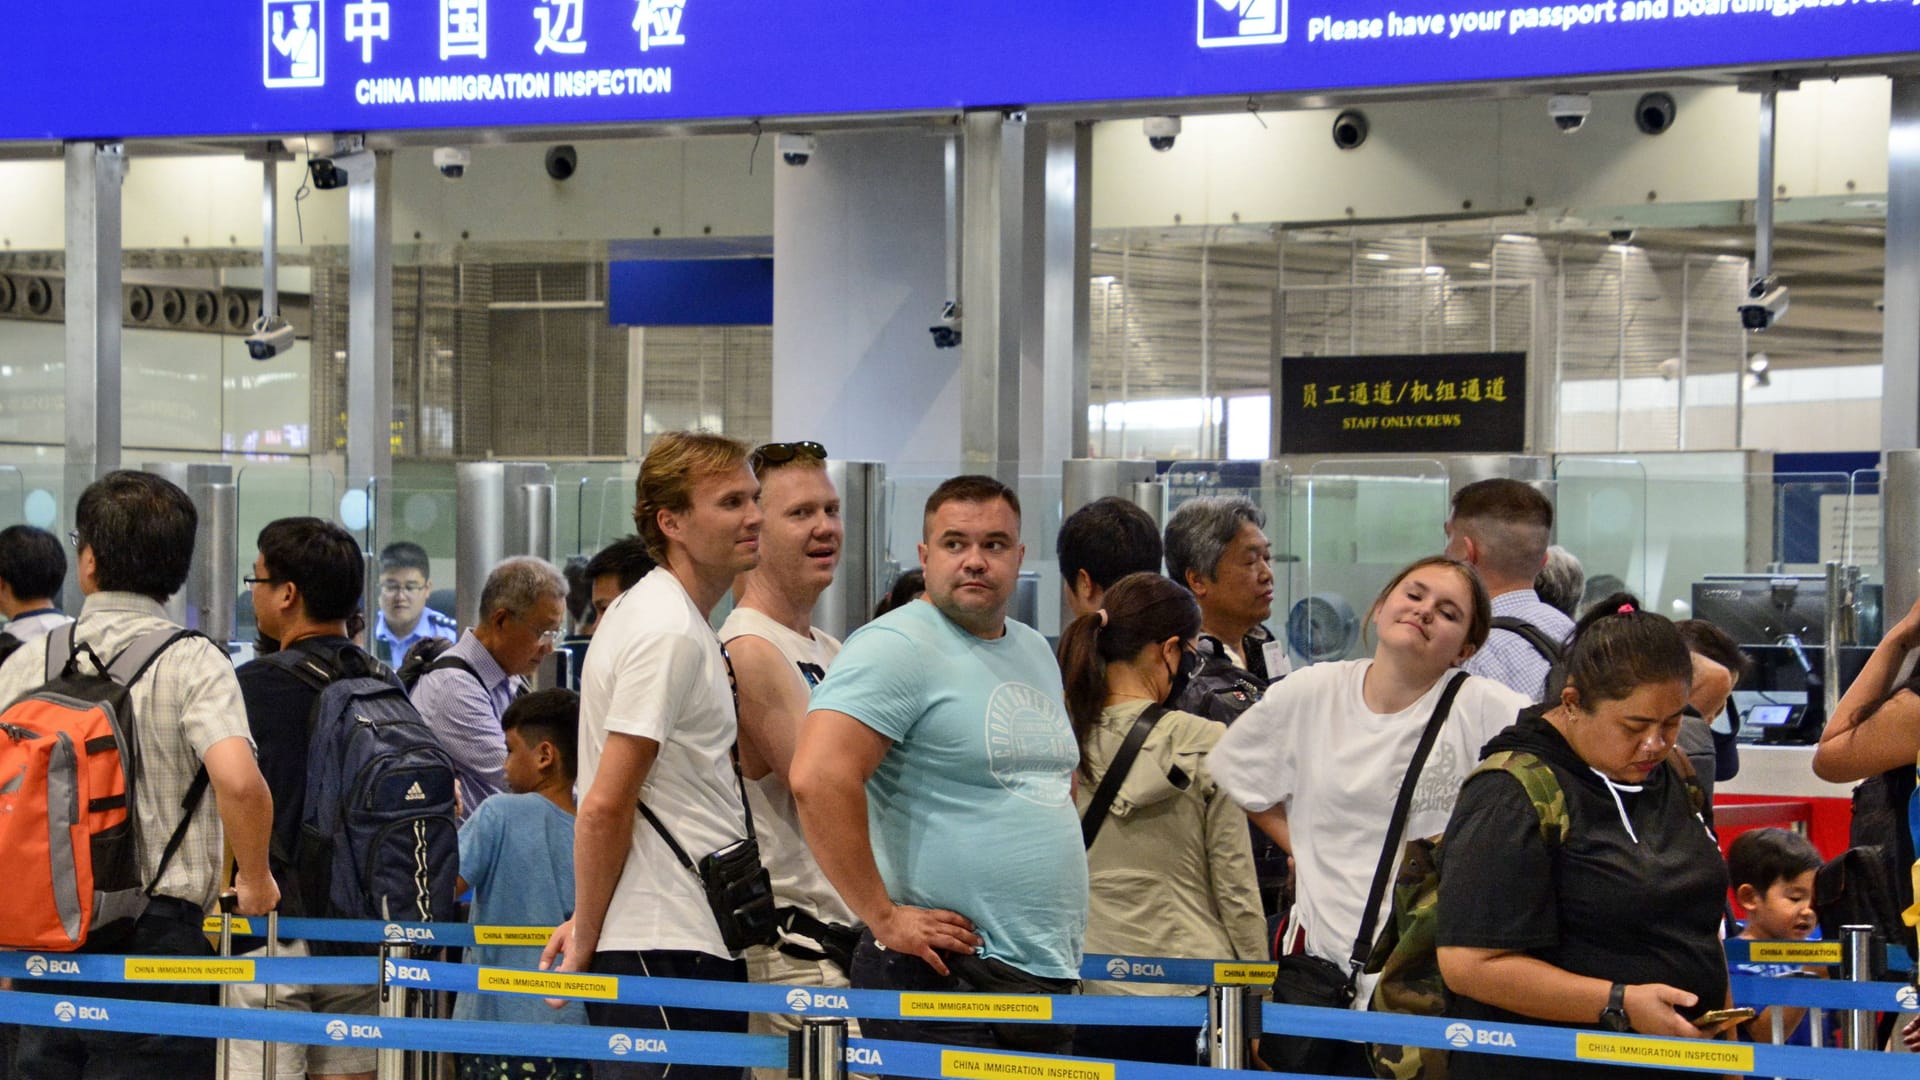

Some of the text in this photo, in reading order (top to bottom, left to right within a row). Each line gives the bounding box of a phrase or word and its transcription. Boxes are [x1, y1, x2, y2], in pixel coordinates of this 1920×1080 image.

[1308, 15, 1384, 42] Please
[1388, 10, 1446, 37] have
[1449, 9, 1506, 39] your
[1509, 0, 1617, 35] passport
[1620, 0, 1668, 21] and
[355, 67, 672, 105] CHINA IMMIGRATION INSPECTION
[1303, 376, 1508, 408] 员工通道/机组通道
[1342, 414, 1462, 430] STAFF ONLY/CREWS
[406, 927, 435, 940] BCIA
[483, 932, 502, 940] CHINA
[504, 932, 546, 940] IMMIGRATION
[1786, 949, 1837, 957] IMMIGRATION
[50, 960, 80, 974] BCIA
[134, 966, 244, 976] CHINA IMMIGRATION INSPECTION
[398, 965, 431, 981] BCIA
[1132, 963, 1165, 977] BCIA
[1223, 970, 1246, 978] CHINA
[488, 976, 606, 992] CHINA IMMIGRATION INSPECTION
[814, 993, 848, 1010] BCIA
[911, 1001, 1039, 1013] CHINA IMMIGRATION INSPECTION
[79, 1006, 109, 1021] BCIA
[351, 1025, 383, 1039] BCIA
[1476, 1030, 1517, 1048] BCIA
[635, 1039, 668, 1053] BCIA
[1588, 1043, 1739, 1063] CHINA IMMIGRATION INSPECTION
[845, 1048, 883, 1066] BCIA
[953, 1060, 1100, 1080] CHINA IMMIGRATION INSPECTION
